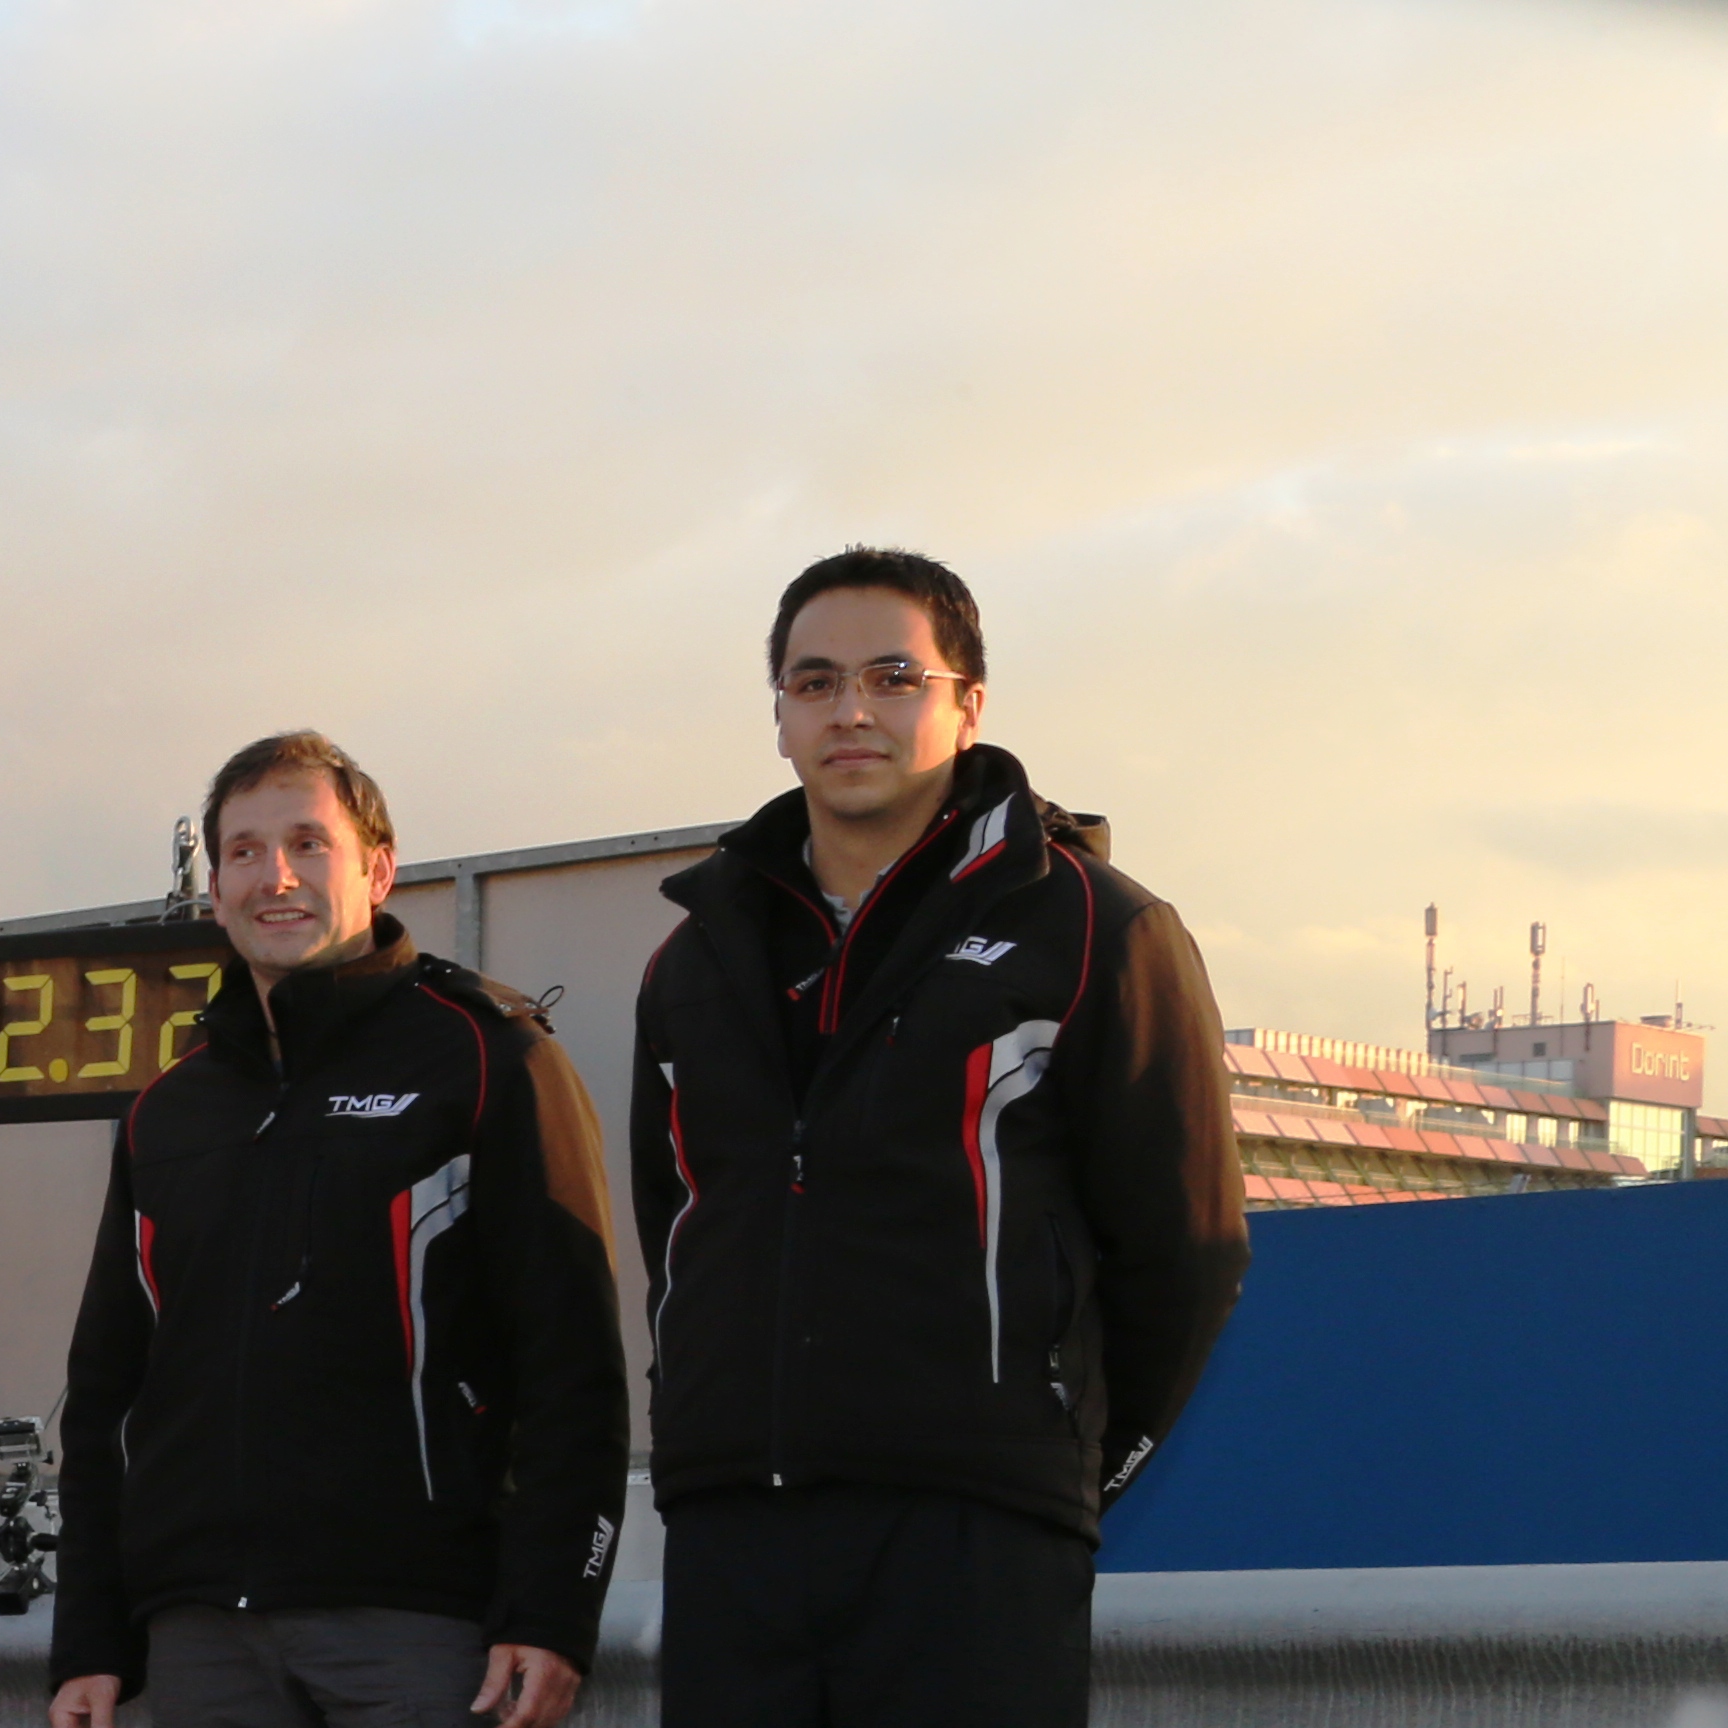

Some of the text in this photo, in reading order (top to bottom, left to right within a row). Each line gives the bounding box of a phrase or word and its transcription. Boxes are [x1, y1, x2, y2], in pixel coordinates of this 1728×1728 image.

[1631, 1042, 1690, 1081] Dorint
[329, 1094, 396, 1112] TMG
[583, 1530, 605, 1578] TMG
